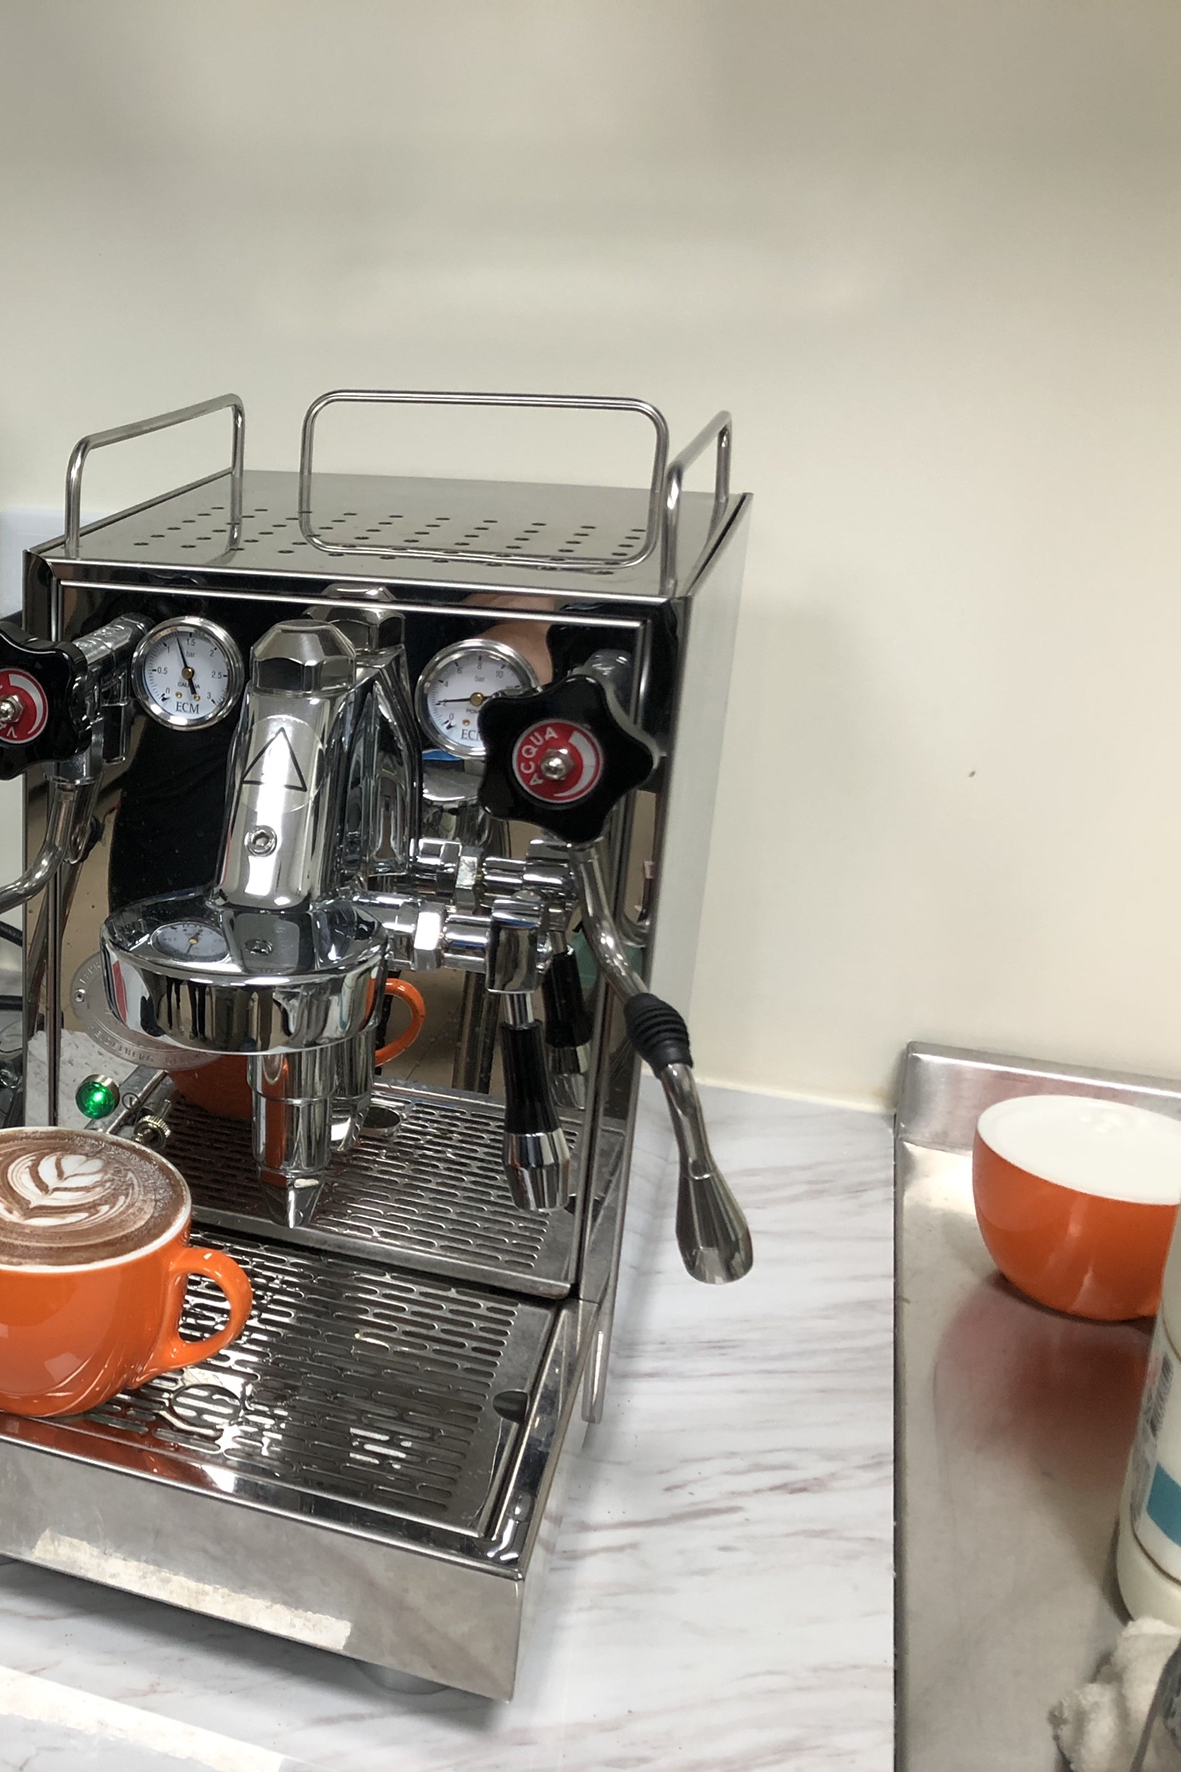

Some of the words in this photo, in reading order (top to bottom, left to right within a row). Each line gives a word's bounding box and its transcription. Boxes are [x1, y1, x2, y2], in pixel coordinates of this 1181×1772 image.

[157, 666, 168, 675] 0.5
[211, 671, 222, 679] 2.5
[177, 681, 201, 689] CALIA
[175, 701, 200, 714] ECM
[460, 729, 479, 740] EC
[520, 726, 558, 786] ACQUA
